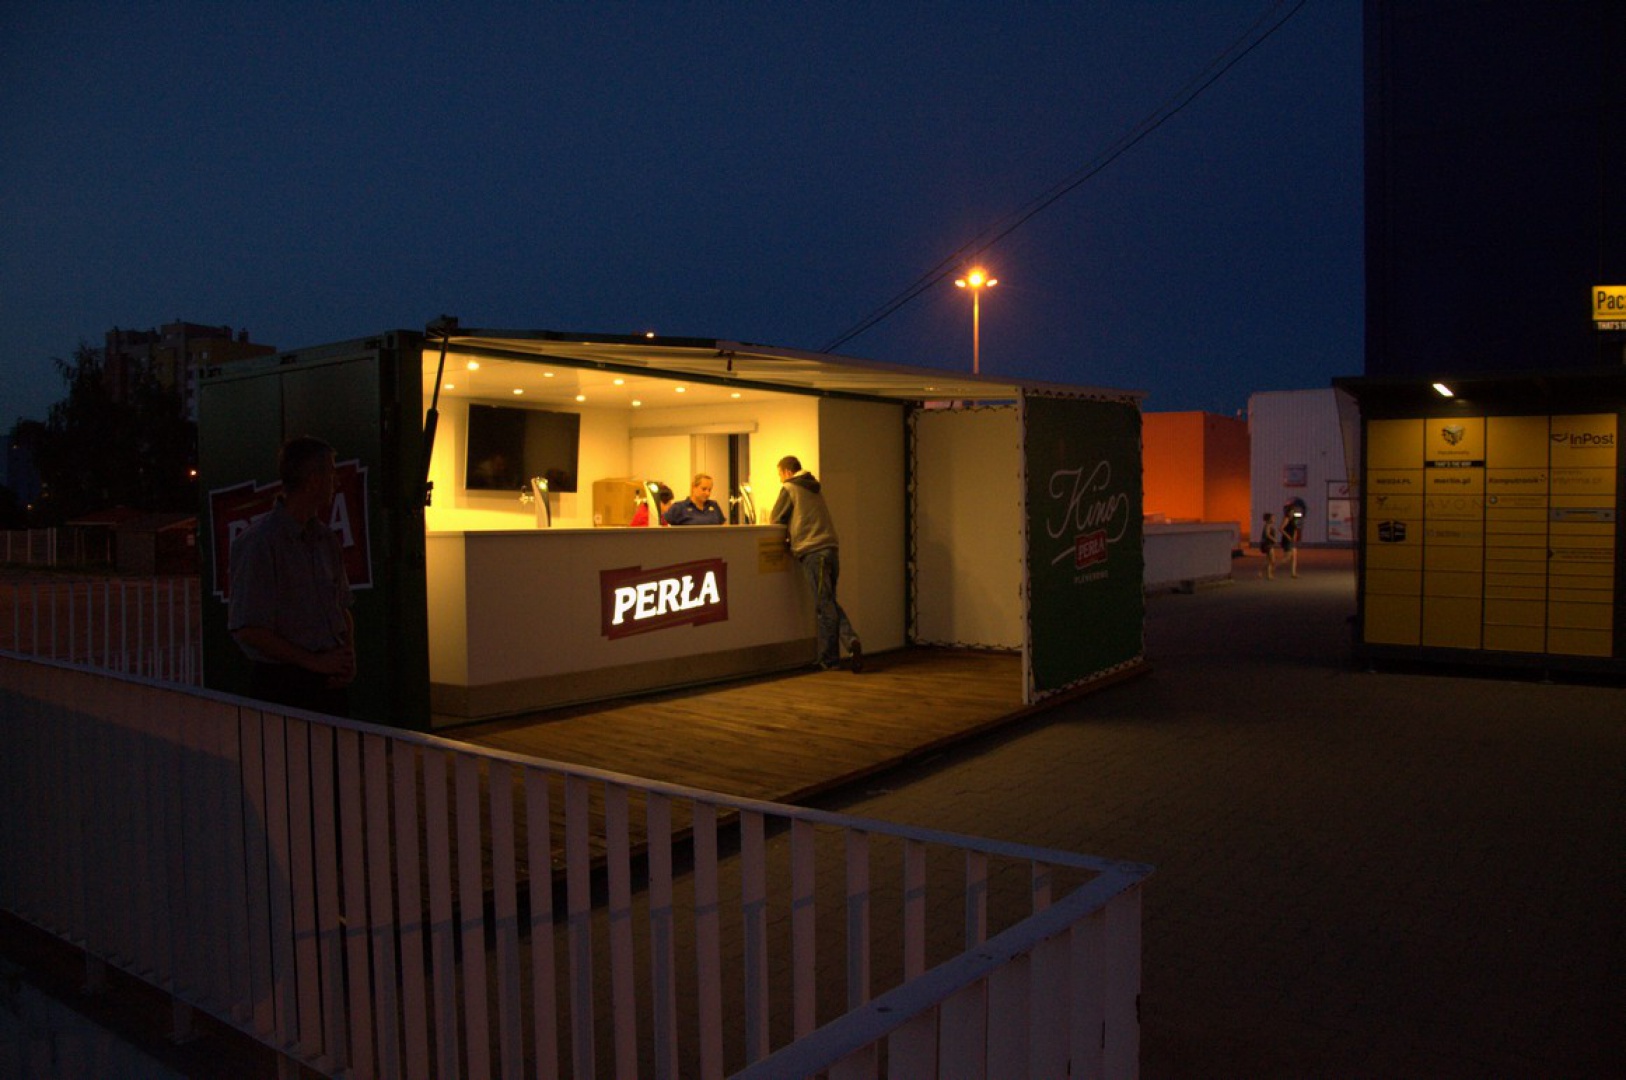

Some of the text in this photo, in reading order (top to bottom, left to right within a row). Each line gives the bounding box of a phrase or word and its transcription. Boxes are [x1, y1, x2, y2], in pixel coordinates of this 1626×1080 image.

[1597, 291, 1626, 309] Pac
[1569, 432, 1614, 445] InPost
[1046, 460, 1130, 542] Kino
[612, 570, 720, 625] PERŁA
